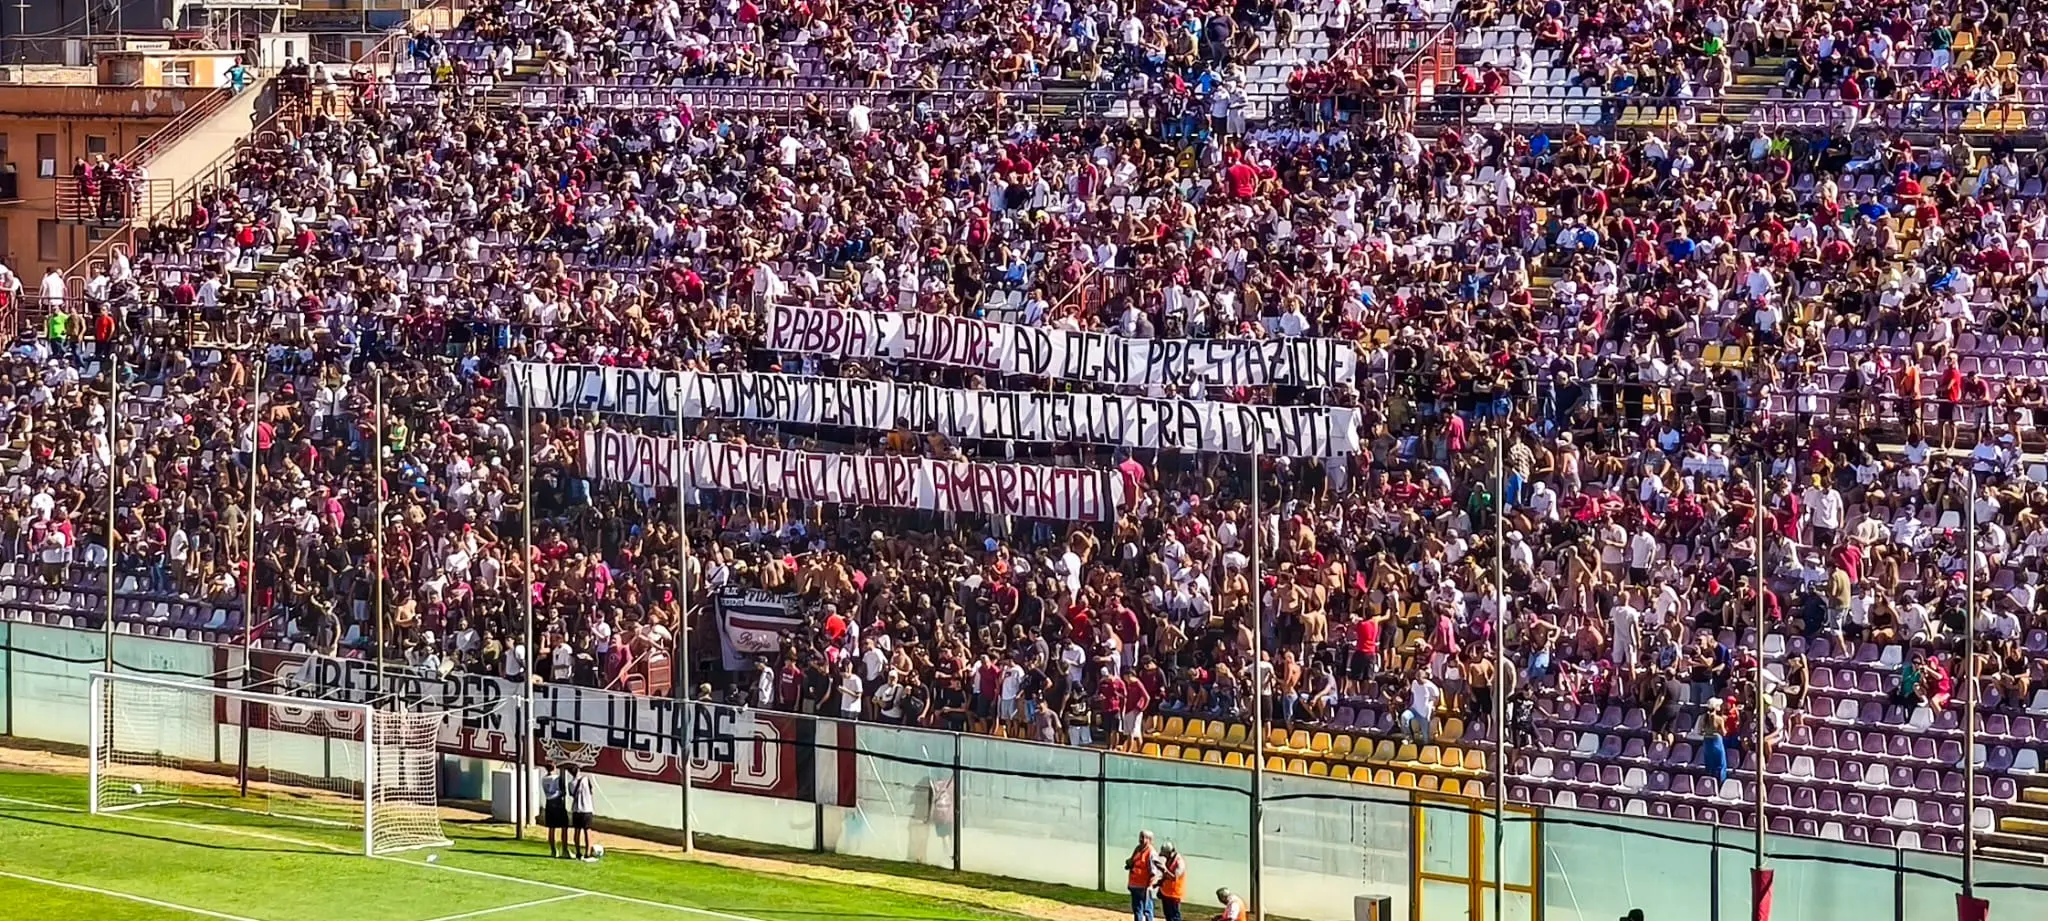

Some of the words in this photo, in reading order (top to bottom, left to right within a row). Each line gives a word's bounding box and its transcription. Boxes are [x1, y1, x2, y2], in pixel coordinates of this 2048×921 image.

[873, 314, 888, 357] E
[901, 312, 1000, 369] SUDORE
[1015, 325, 1052, 373] AD
[978, 391, 1121, 445] COLTELLO
[1136, 397, 1202, 449] FRA
[839, 457, 918, 507] CUORE
[931, 461, 1099, 521] AMARANTO
[607, 695, 735, 763] ULTRAS
